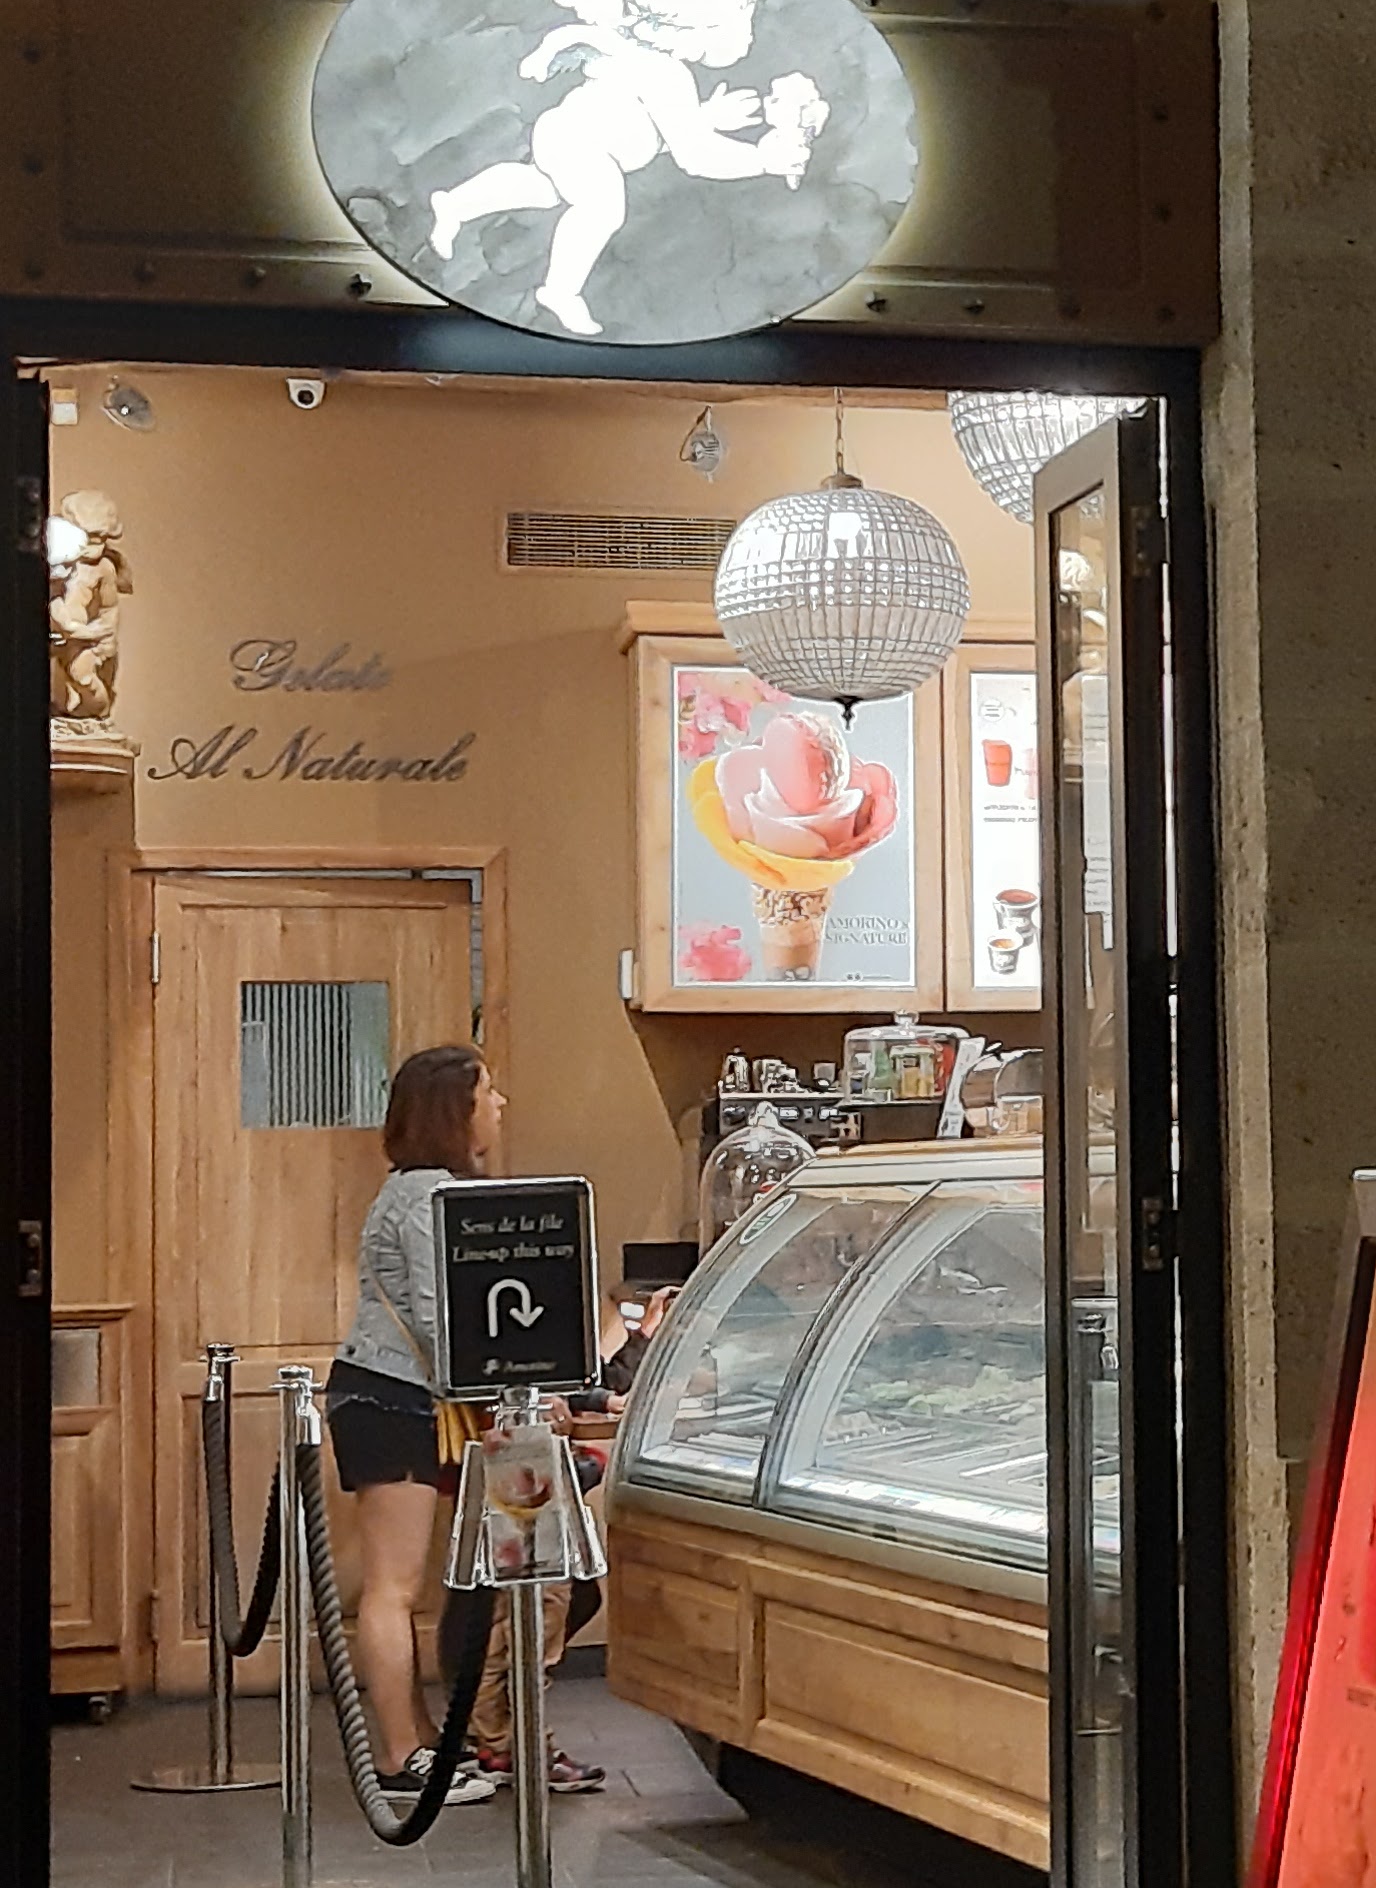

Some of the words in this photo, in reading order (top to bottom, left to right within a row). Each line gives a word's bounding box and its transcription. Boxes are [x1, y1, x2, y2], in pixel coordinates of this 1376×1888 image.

[230, 639, 394, 692] Gelato
[147, 724, 258, 781] Al
[243, 725, 477, 782] Naturale
[497, 1215, 517, 1233] de
[520, 1215, 536, 1232] la
[513, 1241, 541, 1259] this
[544, 1244, 575, 1260] way
